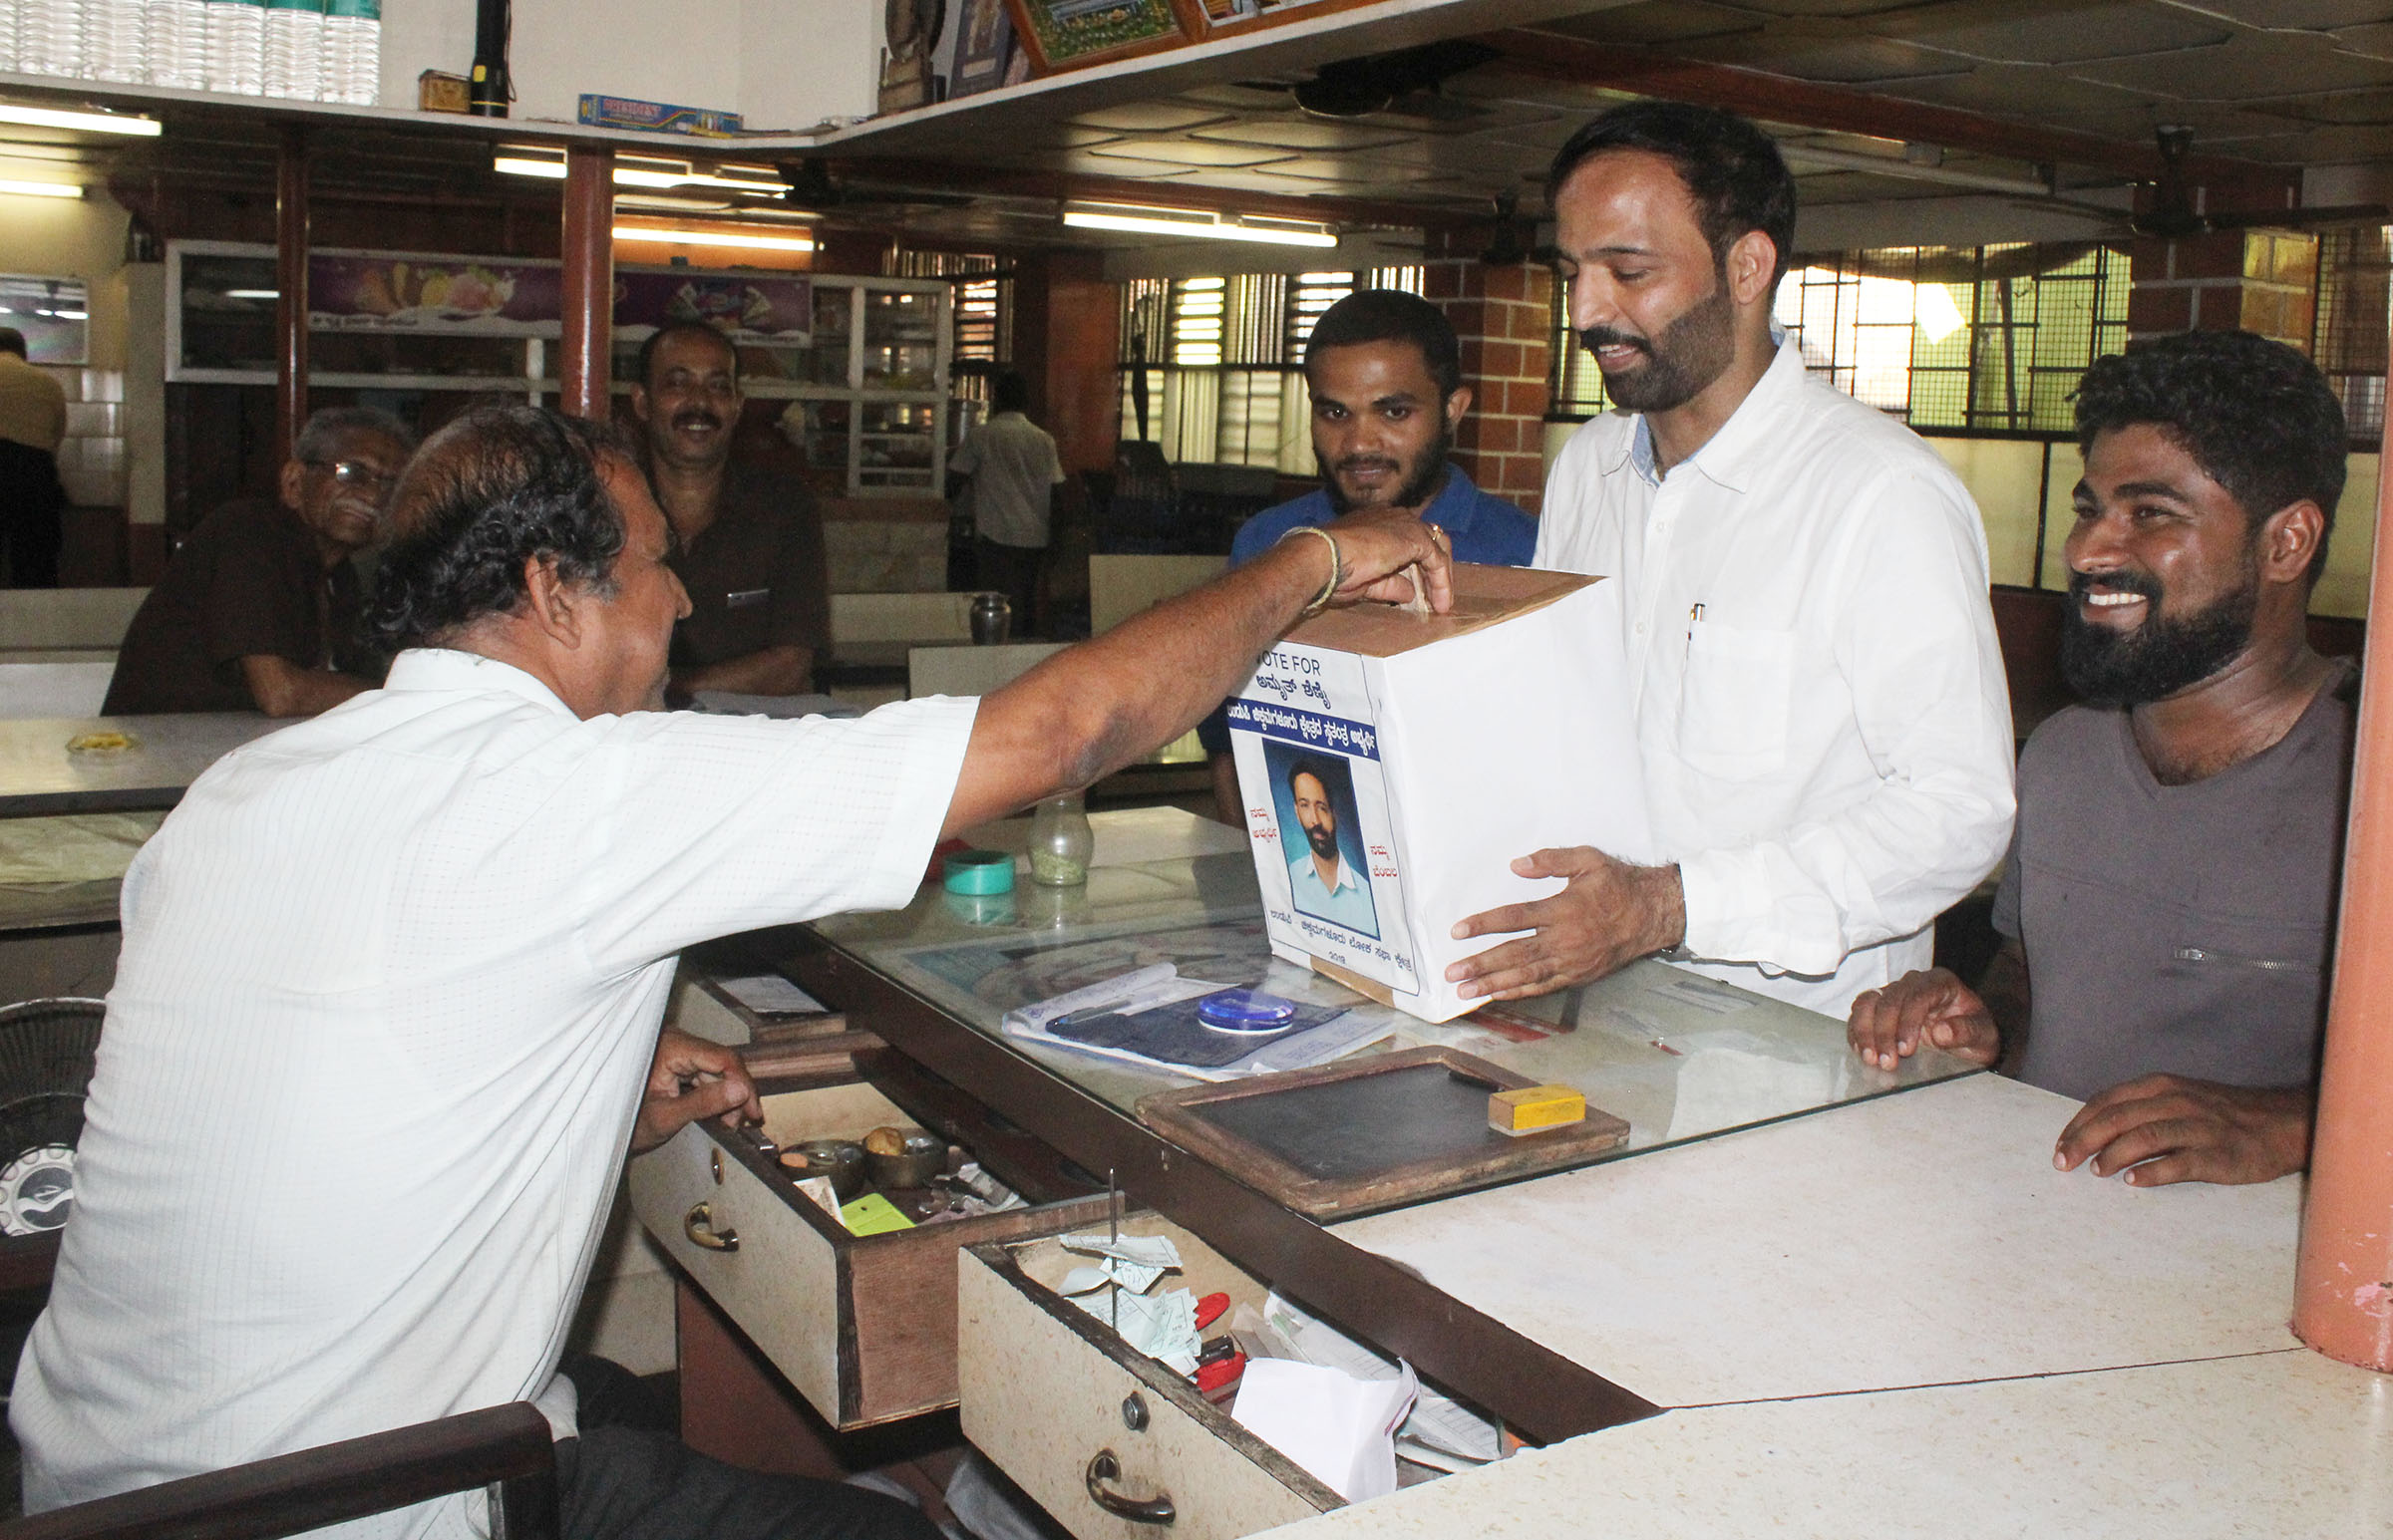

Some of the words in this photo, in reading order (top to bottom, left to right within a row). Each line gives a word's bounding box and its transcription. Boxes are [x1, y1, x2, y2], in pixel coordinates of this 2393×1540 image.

[1291, 656, 1321, 677] FOR
[1256, 673, 1297, 702] ಅಮೃತ್
[1301, 679, 1331, 710] ಶೆಣೈ
[1252, 707, 1298, 731] ಚಿಕ್ಕಮಗಳೂರು
[1299, 715, 1322, 740] ಕ್ಷೇತ್ರದ
[1323, 721, 1349, 747] ಸ್ವತಂತ್ರ
